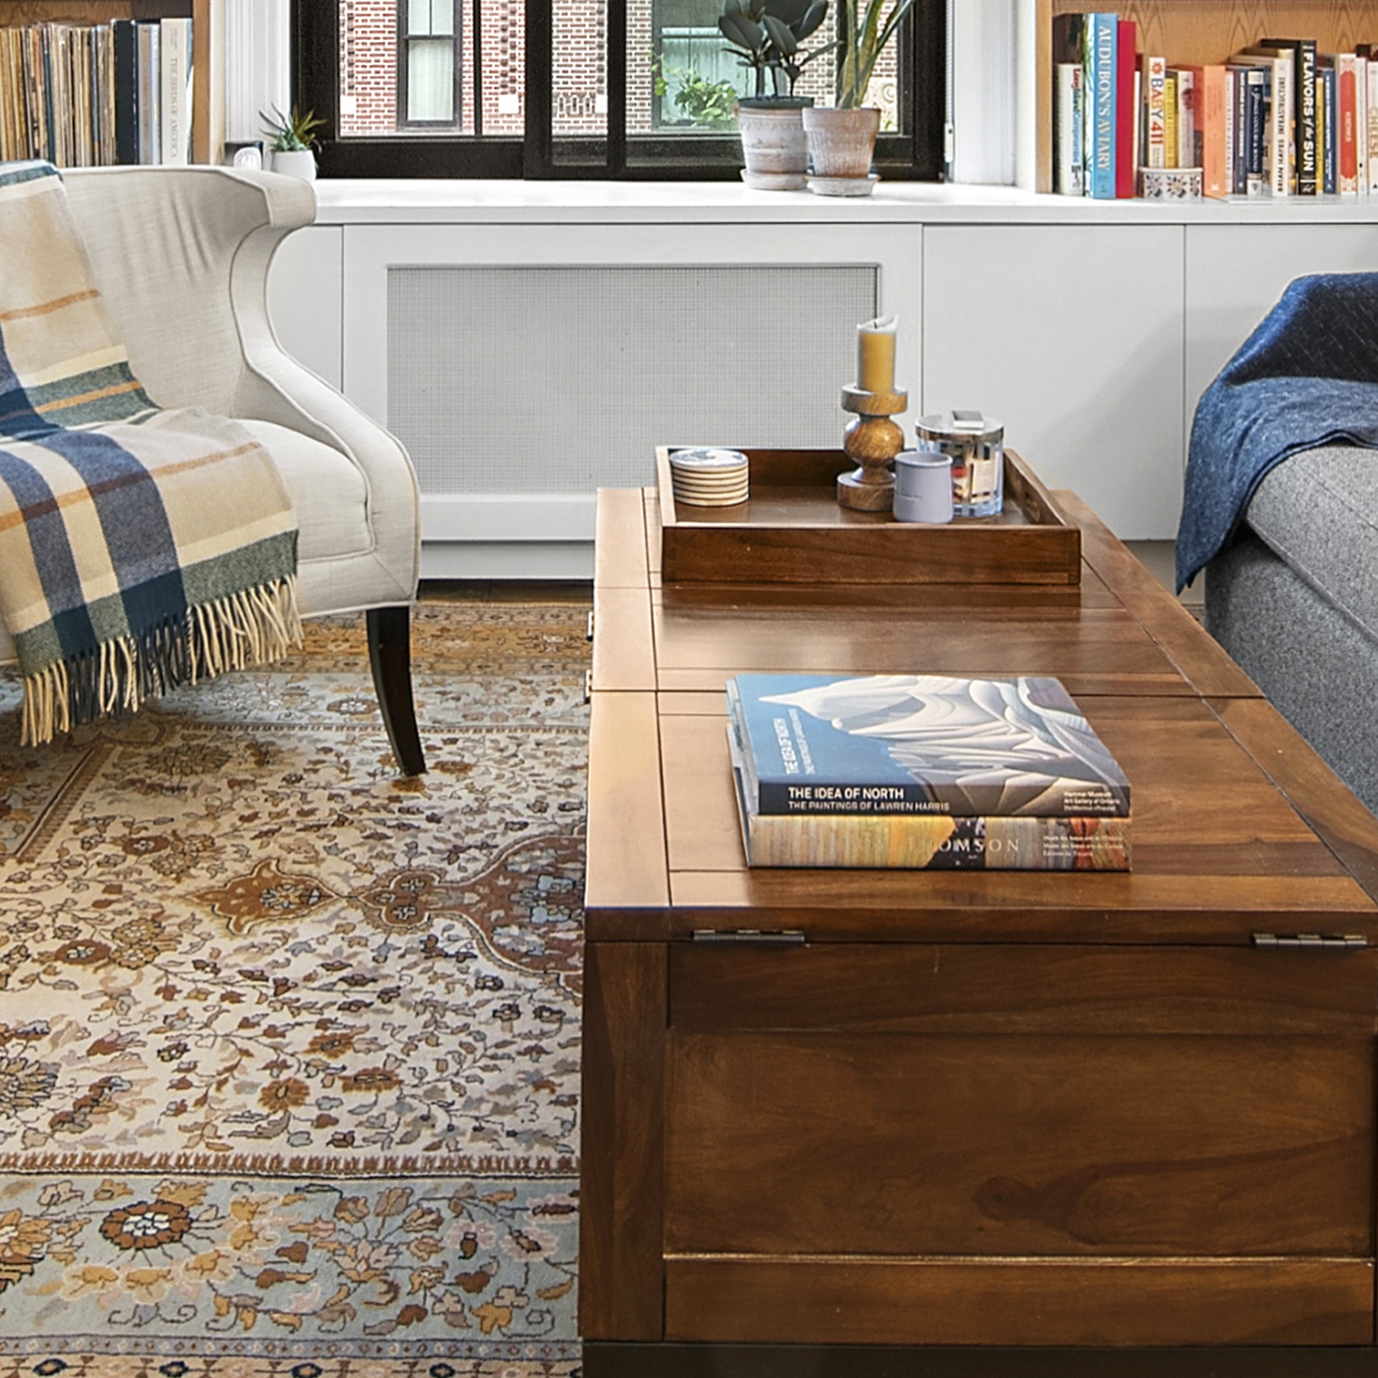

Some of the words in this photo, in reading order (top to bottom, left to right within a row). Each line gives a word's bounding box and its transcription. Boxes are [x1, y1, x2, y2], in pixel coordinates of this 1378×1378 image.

[1098, 26, 1111, 116] AUDUBON'S
[1303, 53, 1314, 116] FLAVORS
[1151, 78, 1162, 120] BABY
[1098, 121, 1110, 170] AVIARY
[1151, 121, 1162, 144] 411
[1304, 127, 1313, 139] the
[1369, 107, 1378, 159] CHEESE
[1304, 141, 1313, 171] SUN
[1277, 167, 1285, 192] BRIAN
[788, 787, 812, 799] THE
[814, 788, 842, 799] IDEA
[844, 788, 861, 799] OF
[862, 788, 904, 799] NORTH
[788, 801, 808, 810] THE
[809, 802, 858, 810] PAINTINGS
[860, 802, 873, 810] OF
[874, 802, 914, 810] LAWREN
[915, 802, 950, 811] HARRIS
